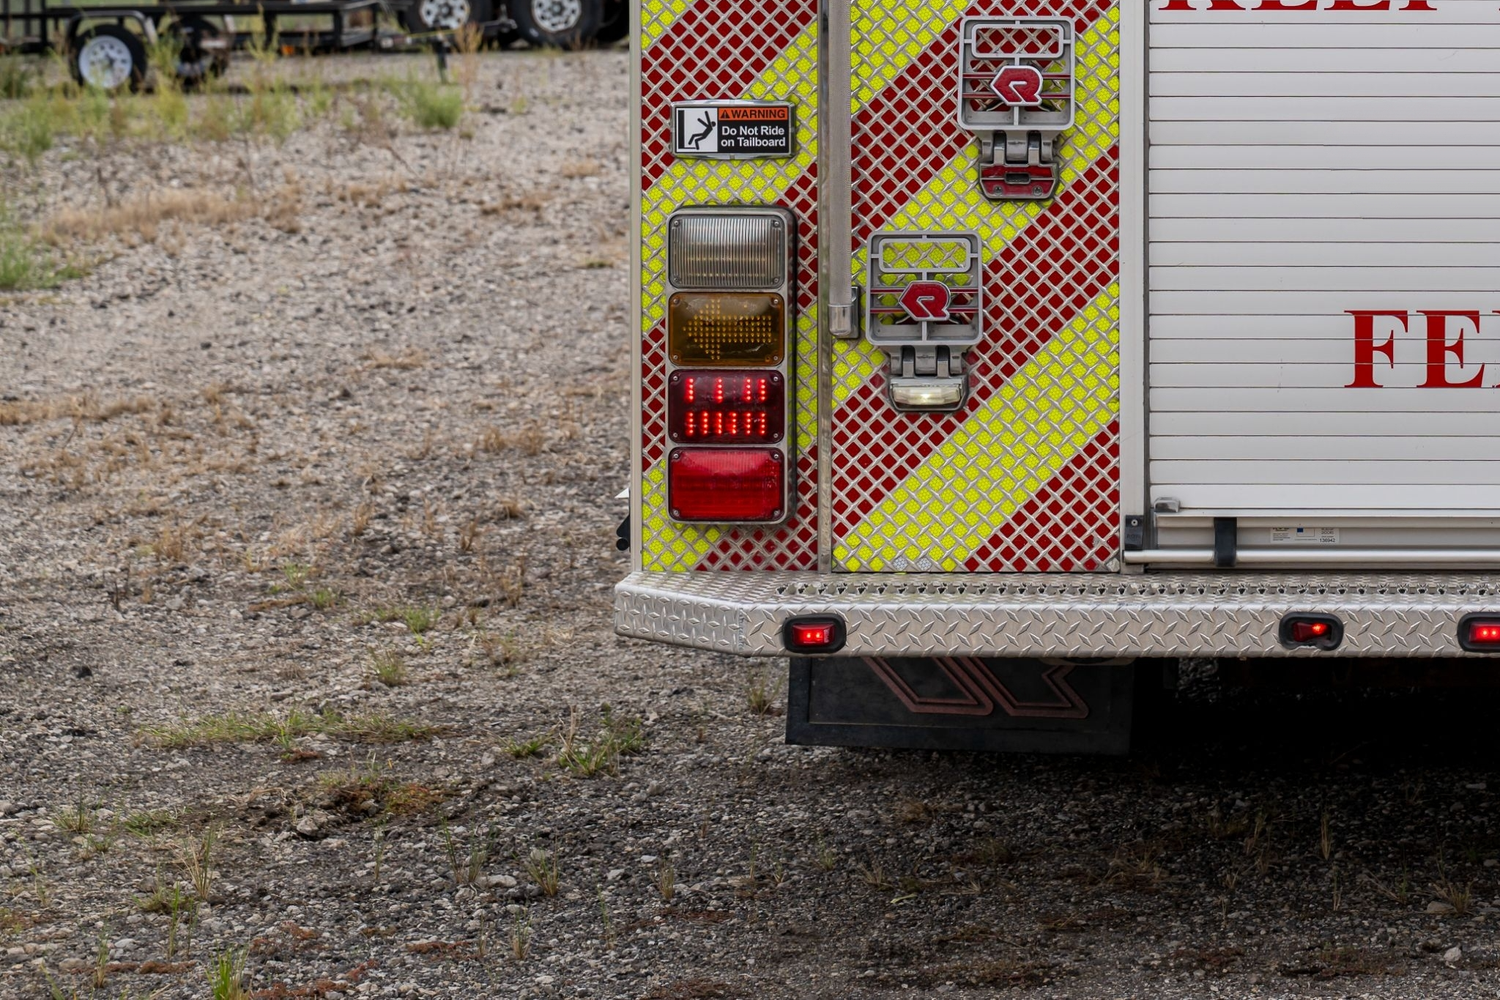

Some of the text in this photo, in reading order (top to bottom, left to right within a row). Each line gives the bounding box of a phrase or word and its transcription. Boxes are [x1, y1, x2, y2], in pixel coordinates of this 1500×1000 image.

[731, 109, 786, 119] WARNING
[722, 126, 785, 136] Do Not Ride
[737, 137, 786, 147] Tailboard
